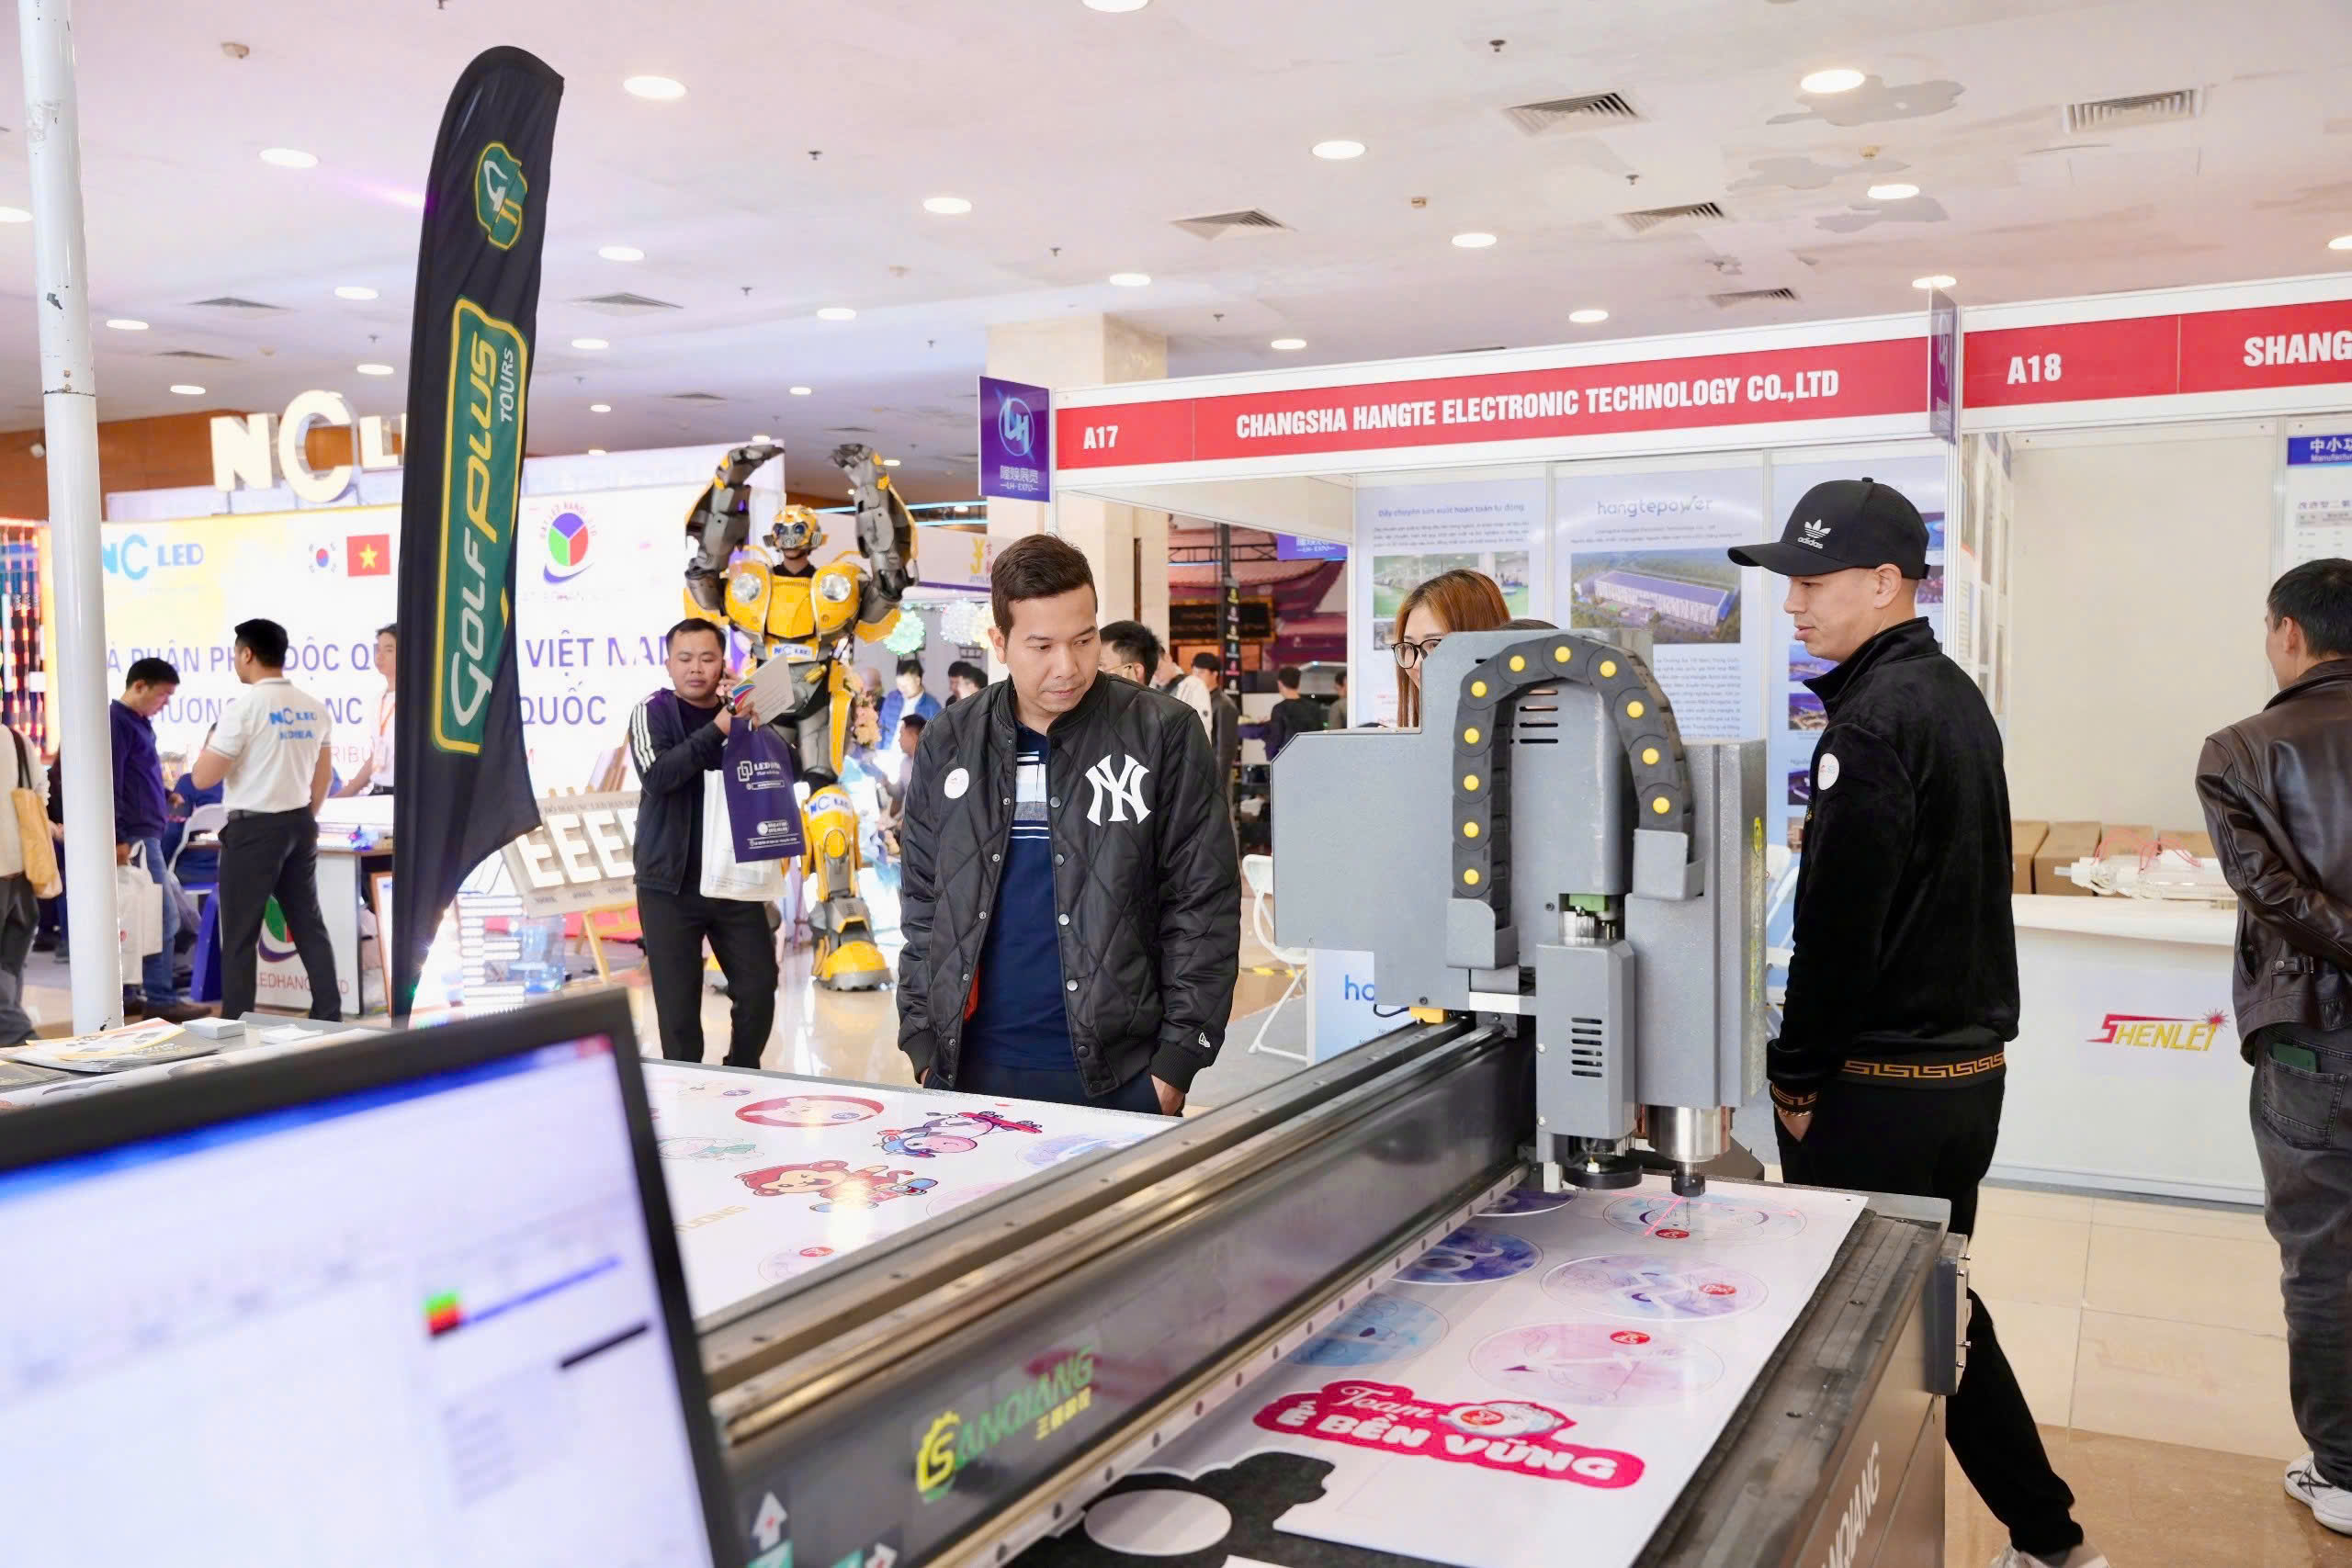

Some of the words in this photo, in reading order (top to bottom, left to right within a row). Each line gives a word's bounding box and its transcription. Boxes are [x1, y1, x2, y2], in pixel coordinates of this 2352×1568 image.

[2244, 331, 2352, 367] SHANG
[500, 348, 514, 423] TOURS
[2007, 353, 2063, 385] A18
[1236, 410, 1348, 439] CHANGSHA
[1353, 400, 1435, 430] HANGTE
[1442, 390, 1578, 423] ELECTRONIC
[1587, 378, 1741, 413] TECHNOLOGY
[1747, 369, 1839, 403] CO.,LTD
[1083, 425, 1119, 450] A17
[1597, 495, 1713, 517] hangtepower
[157, 543, 204, 567] LED
[1797, 536, 1824, 549] adidas
[525, 629, 595, 677] VIỆT
[1085, 753, 1152, 827] NY
